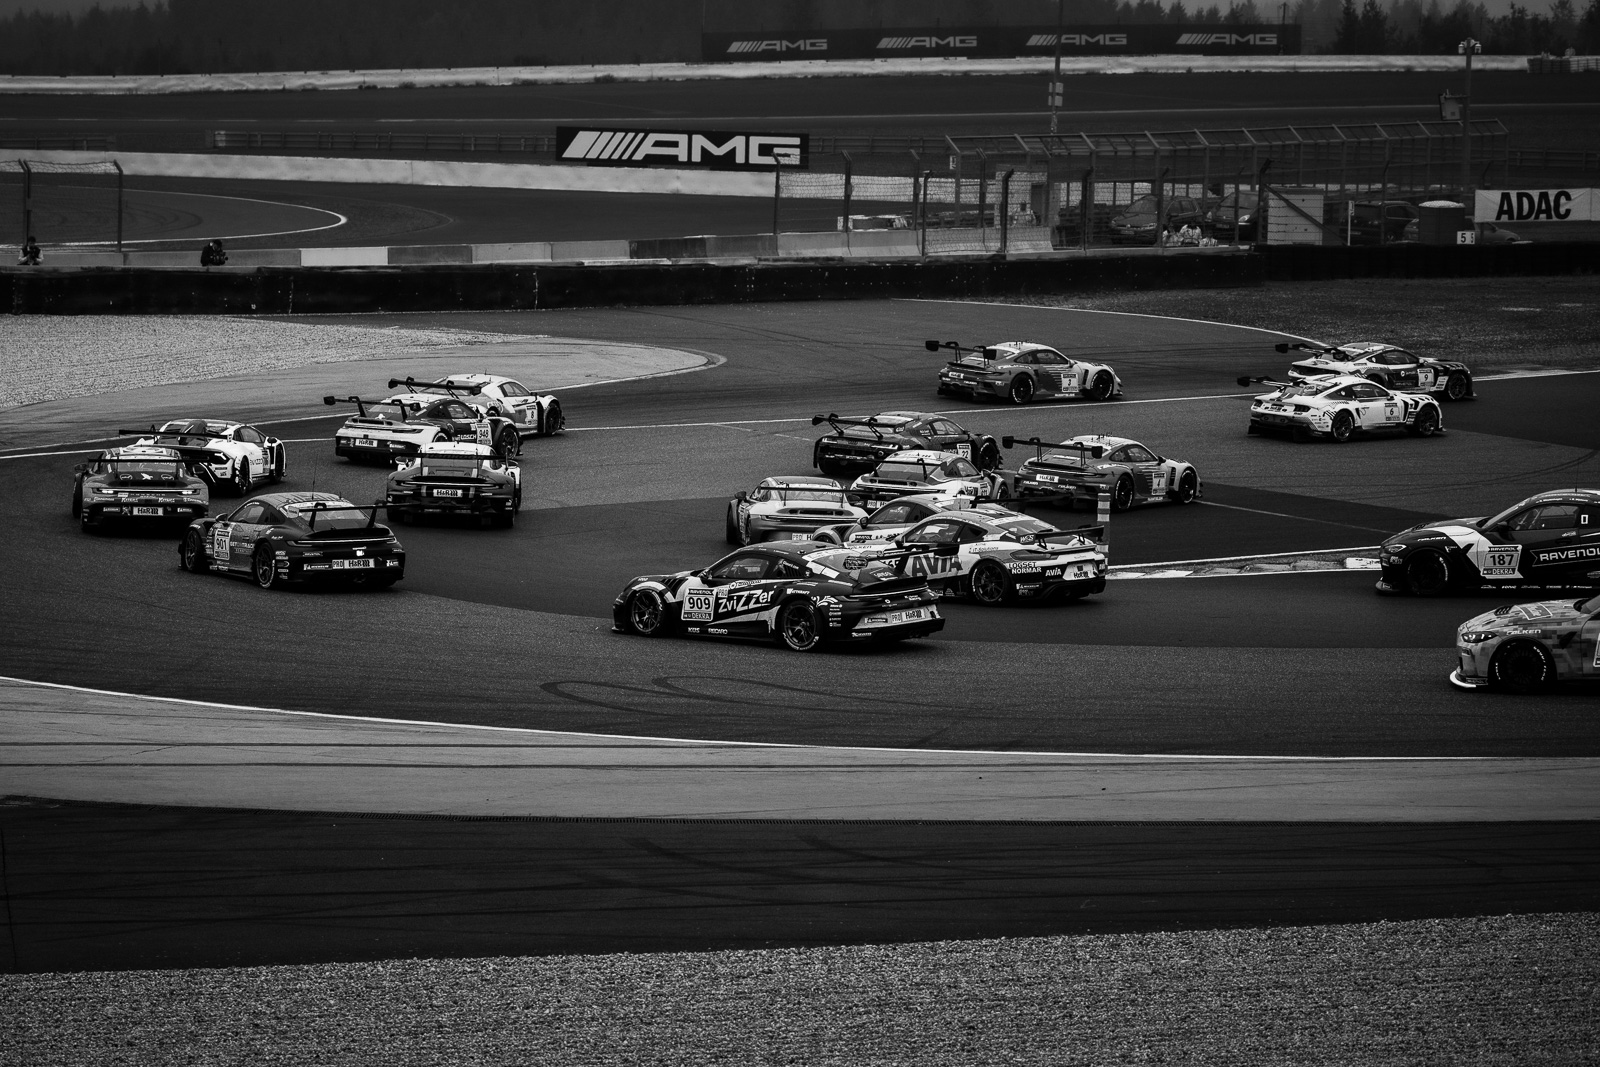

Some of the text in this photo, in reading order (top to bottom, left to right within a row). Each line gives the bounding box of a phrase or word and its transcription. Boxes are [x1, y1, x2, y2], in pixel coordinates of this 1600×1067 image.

[756, 39, 828, 51] AMG
[905, 36, 977, 48] AMG
[1060, 34, 1127, 46] AMG
[1205, 33, 1278, 45] AMG
[631, 133, 801, 165] AMG
[1495, 190, 1571, 220] ADAC
[216, 538, 227, 550] 901
[912, 554, 963, 578] AVIA
[1490, 554, 1515, 566] 187
[1011, 567, 1042, 575] NORMAR
[1045, 568, 1061, 577] AVIA
[1492, 568, 1514, 576] DEKRA
[688, 597, 711, 609] 909
